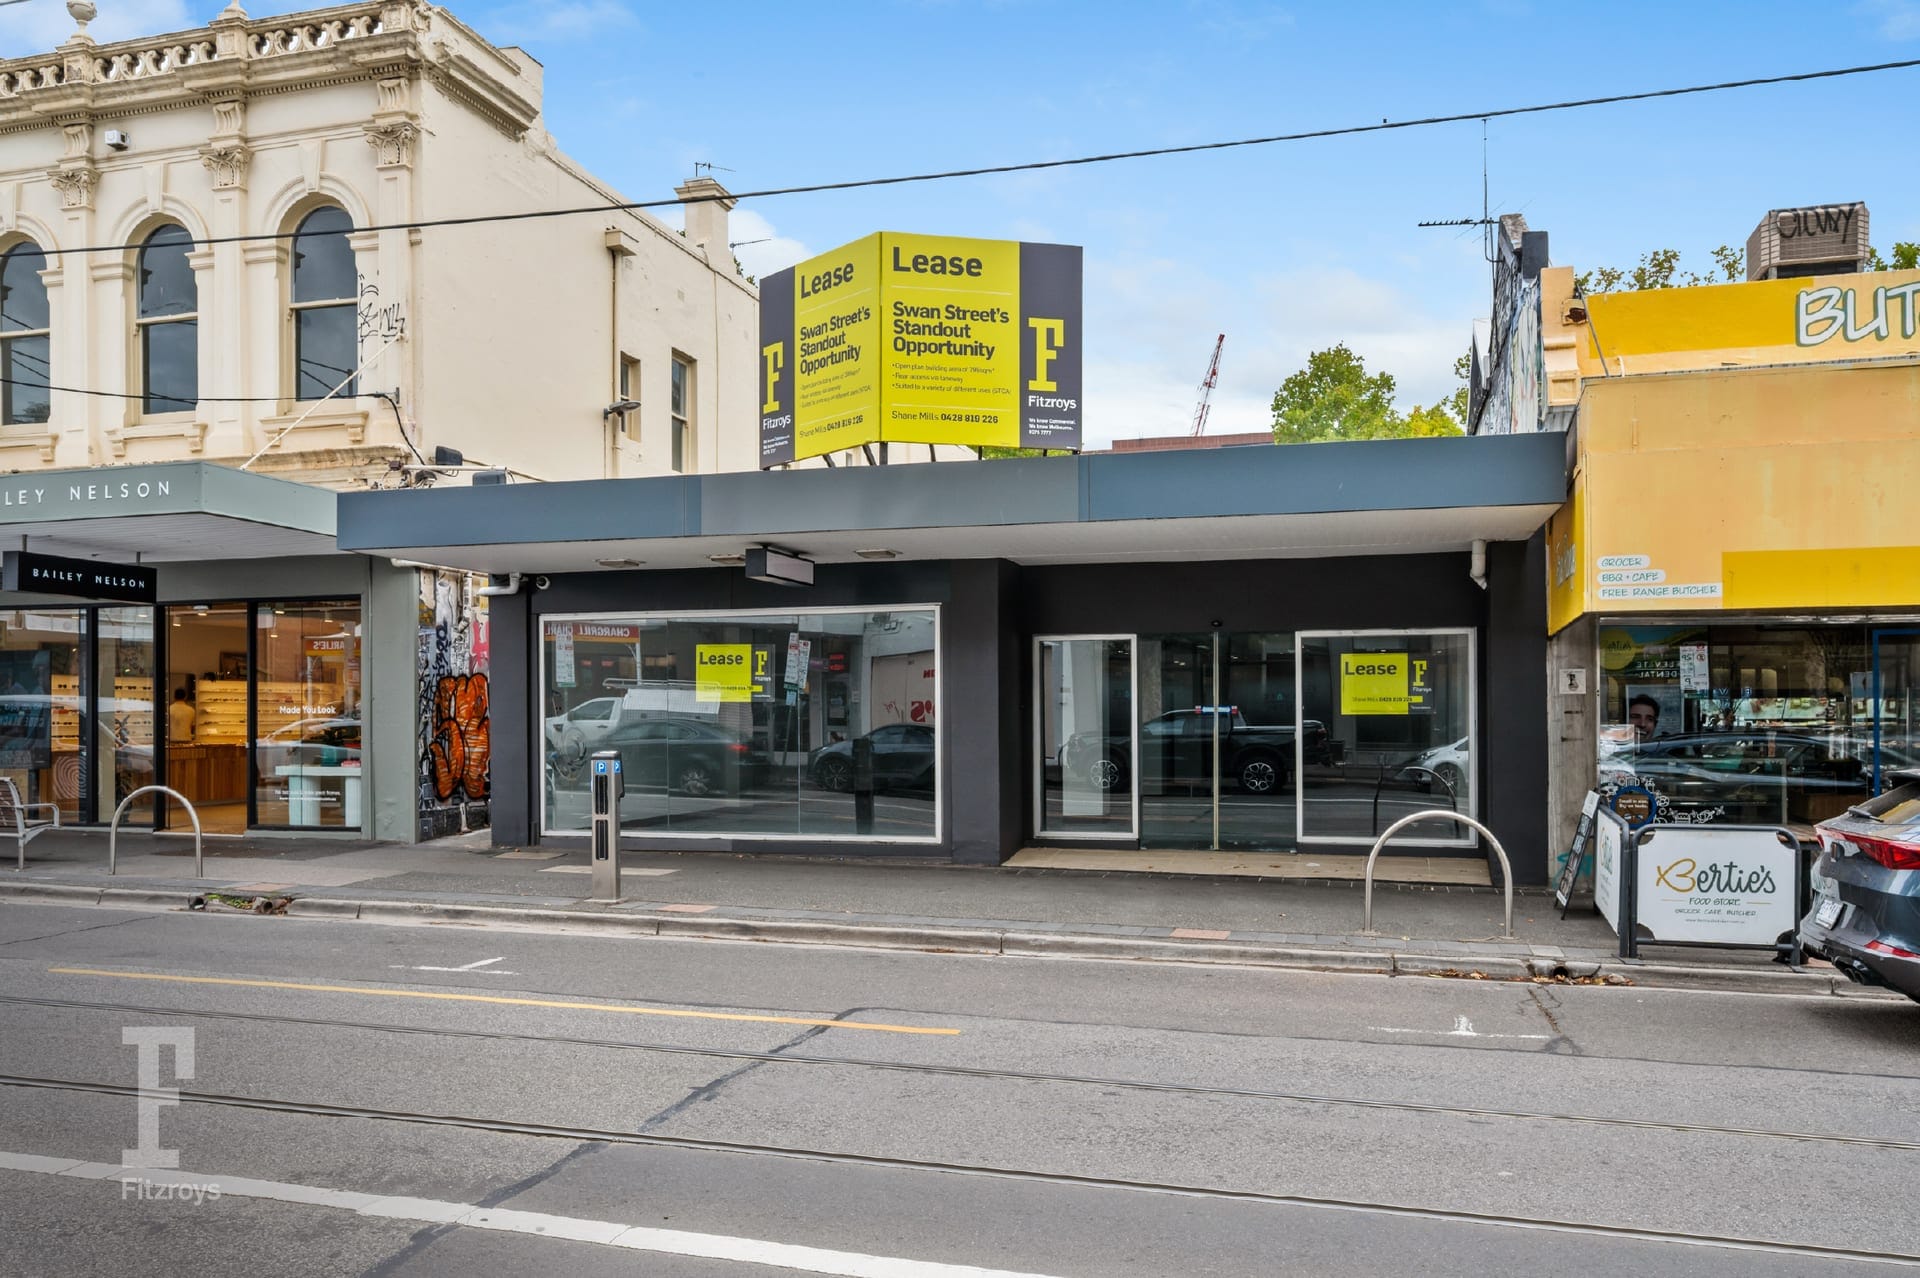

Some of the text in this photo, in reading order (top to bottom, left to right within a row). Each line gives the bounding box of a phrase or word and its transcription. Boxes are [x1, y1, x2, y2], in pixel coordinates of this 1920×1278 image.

[893, 246, 983, 277] Lease
[801, 262, 854, 299] Lease
[800, 306, 871, 341] Swan Street's
[893, 301, 1010, 323] Swan Street's
[1795, 281, 1920, 347] BUT
[893, 319, 971, 338] Standout
[800, 332, 846, 358] Standout
[893, 336, 995, 360] Opportunity
[1028, 317, 1064, 392] F
[800, 344, 861, 376] Opportunity
[763, 341, 784, 414] F
[1028, 395, 1077, 411] Fitzroys
[763, 414, 791, 431] Fitzroys
[891, 410, 917, 420] Shane
[919, 412, 940, 420] Mills
[940, 413, 962, 421] 0428
[982, 415, 999, 424] 226
[5, 481, 169, 506] LEY NELSON
[1601, 557, 1642, 567] GROCER
[32, 568, 145, 588] BAILEY NELSON
[1601, 573, 1623, 582] BBQ
[1601, 585, 1718, 597] FREE RANGE BUTCHER
[699, 651, 743, 665] Lease
[755, 650, 768, 676] F
[1344, 661, 1397, 675] Lease
[1412, 660, 1427, 687] F
[279, 706, 336, 714] Made You Look
[1656, 858, 1776, 894] Bertie's
[1689, 897, 1741, 906] FOOD STORE
